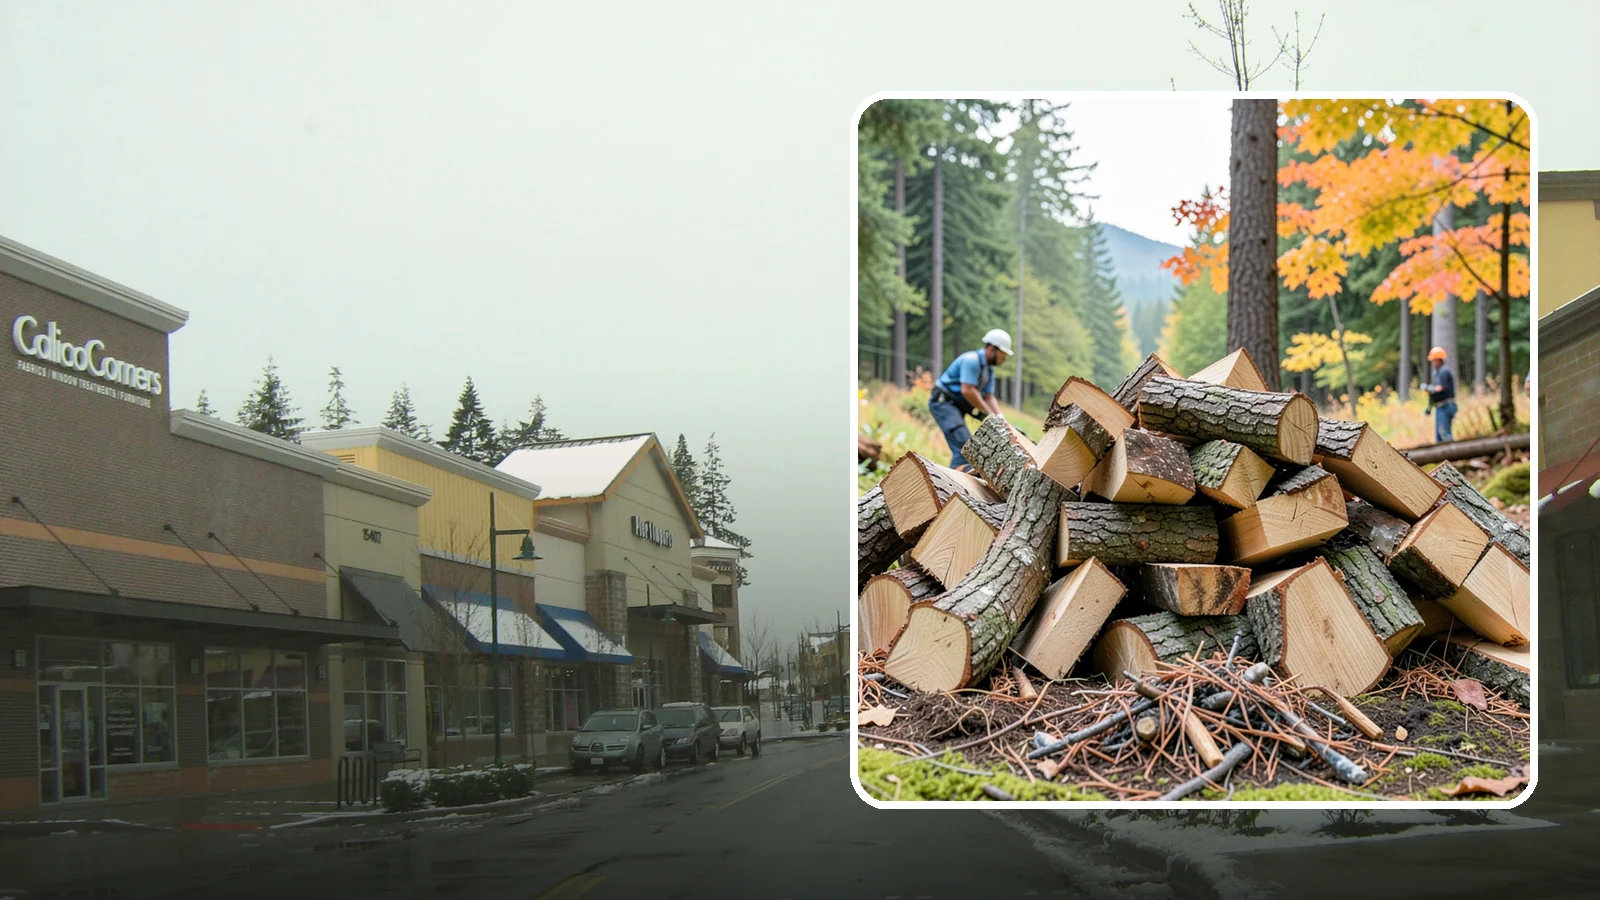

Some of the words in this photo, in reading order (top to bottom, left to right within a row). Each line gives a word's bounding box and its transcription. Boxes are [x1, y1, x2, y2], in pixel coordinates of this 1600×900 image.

[16, 360, 47, 378] FABRICS
[51, 370, 78, 387] WINDOW
[79, 378, 116, 398] TREATMENTS
[120, 391, 151, 409] FURNITURE
